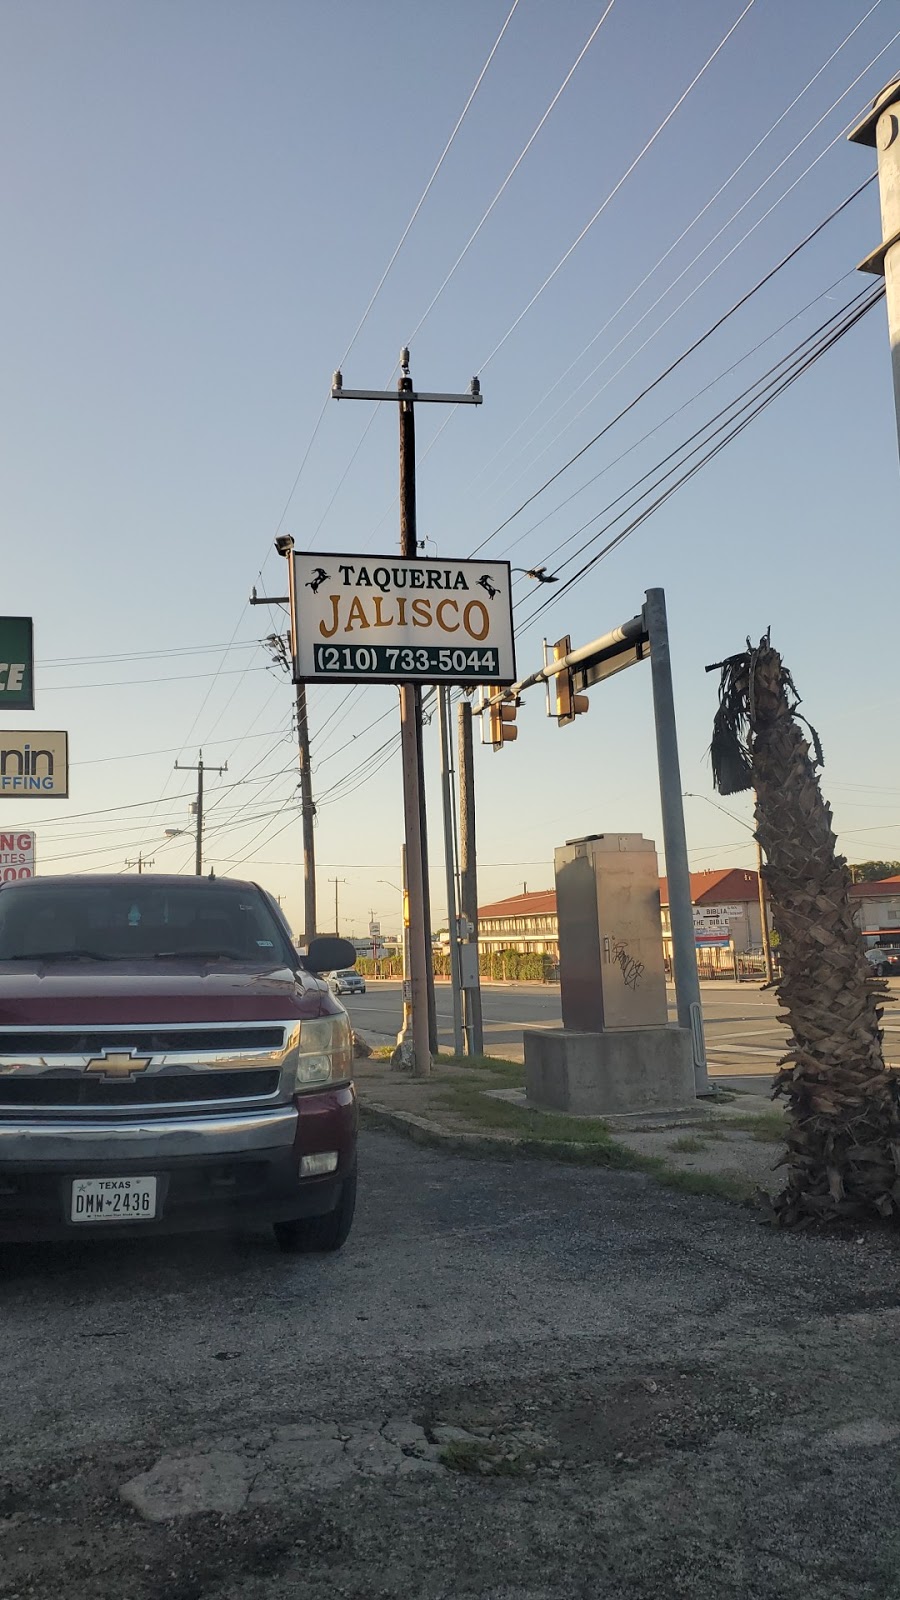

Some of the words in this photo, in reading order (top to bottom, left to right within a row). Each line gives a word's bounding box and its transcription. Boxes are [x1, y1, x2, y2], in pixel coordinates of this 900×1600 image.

[339, 565, 469, 592] TAQUERIA
[319, 595, 490, 641] JALISCO
[317, 648, 377, 670] (210)
[385, 649, 496, 671] 733-5044
[2, 776, 54, 789] FFING
[0, 853, 26, 864] TES
[709, 918, 729, 926] BIBLE
[99, 1181, 131, 1190] TEXAS
[76, 1194, 104, 1213] DMW
[113, 1192, 150, 1212] 2436
